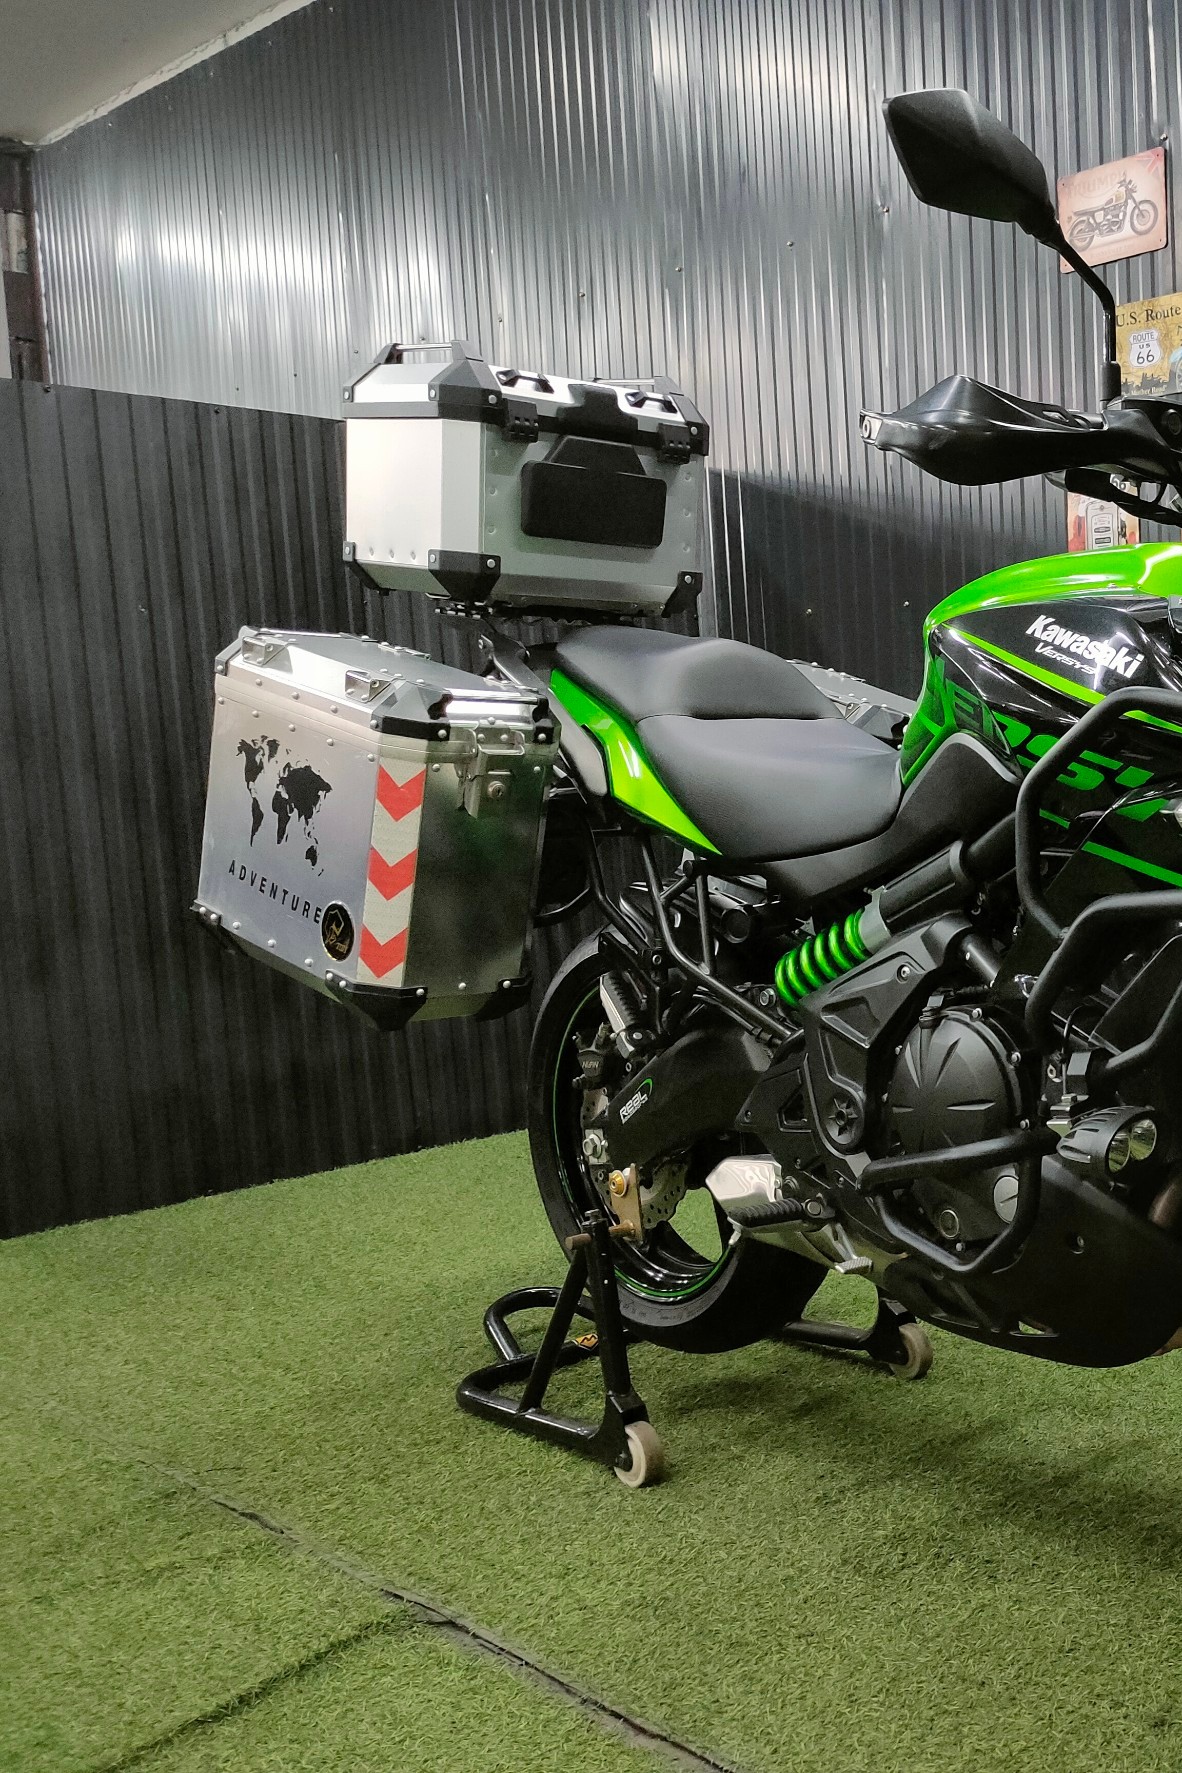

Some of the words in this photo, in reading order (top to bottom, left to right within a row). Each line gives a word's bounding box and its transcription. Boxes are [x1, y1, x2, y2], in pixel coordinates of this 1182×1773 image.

[1116, 311, 1141, 328] U.S.
[1145, 305, 1182, 323] Route
[1132, 331, 1155, 343] ROUTE
[1136, 349, 1155, 365] 66
[1025, 614, 1145, 679] Kawasaki
[228, 860, 322, 925] ADVENTURE
